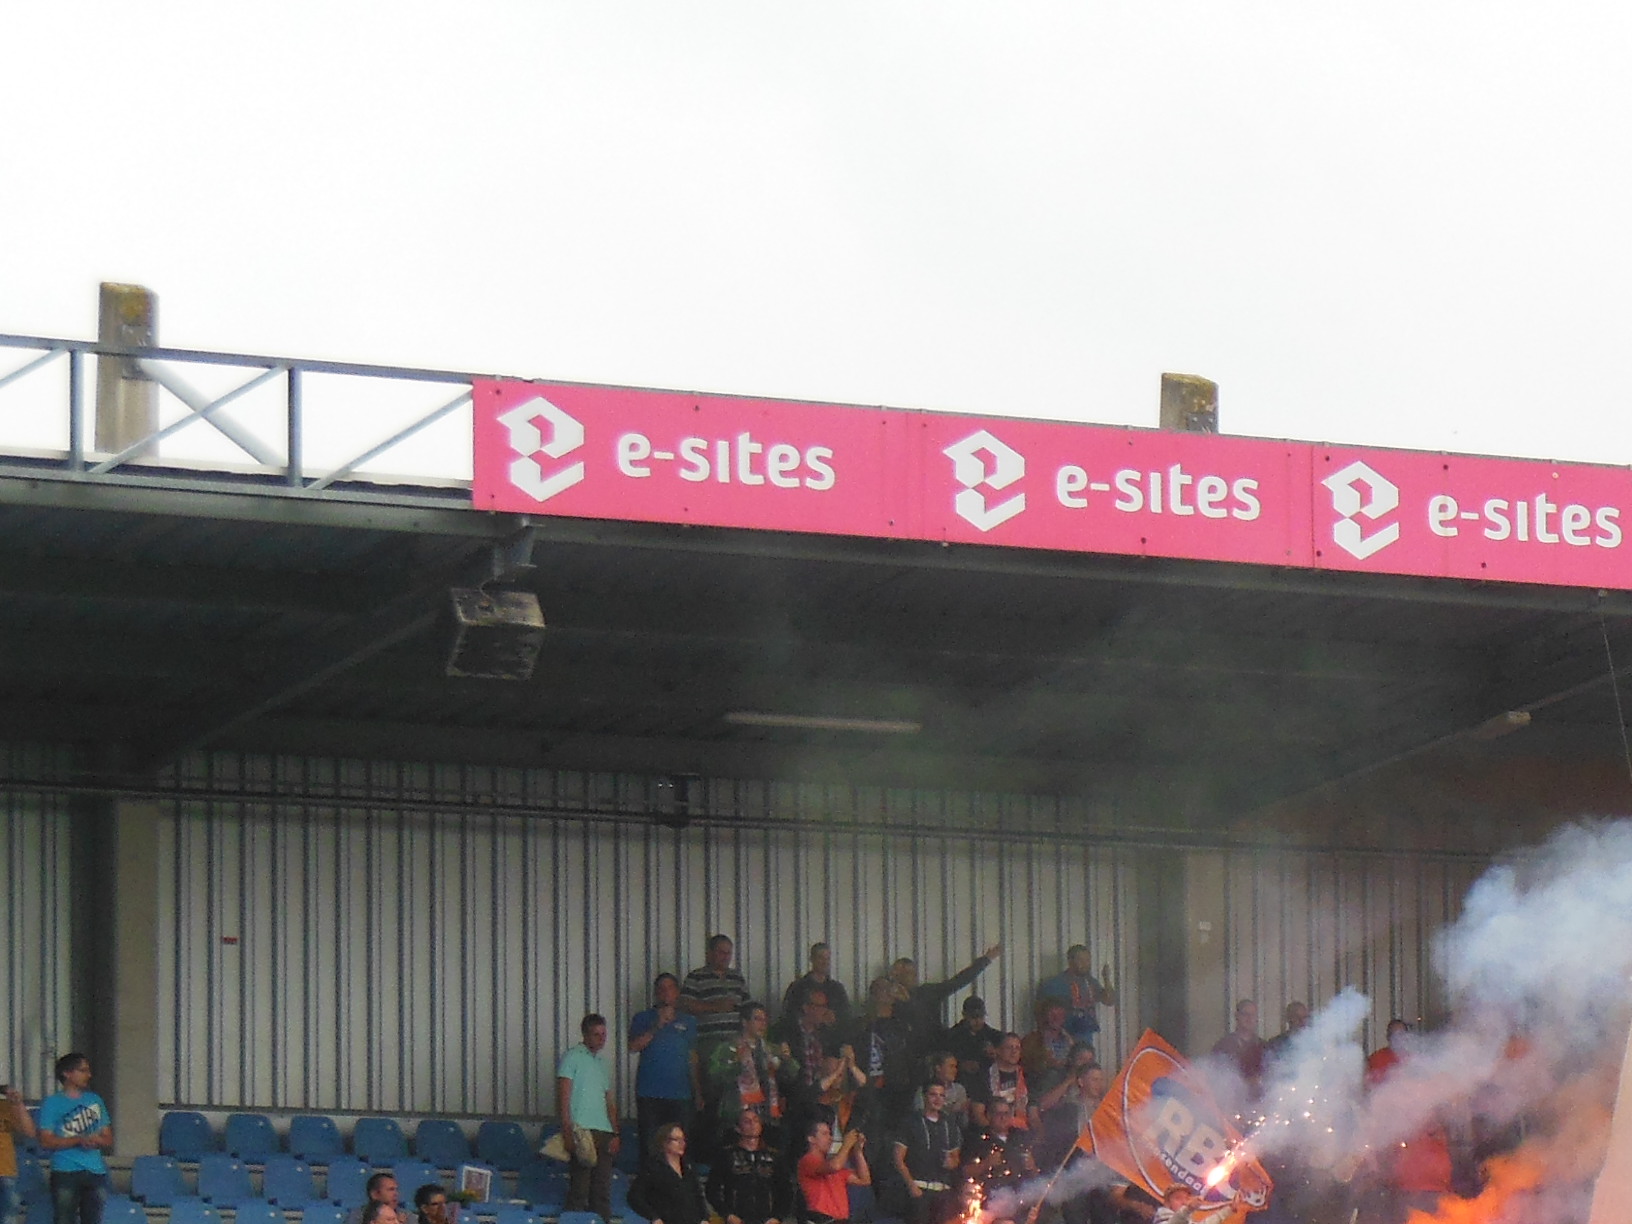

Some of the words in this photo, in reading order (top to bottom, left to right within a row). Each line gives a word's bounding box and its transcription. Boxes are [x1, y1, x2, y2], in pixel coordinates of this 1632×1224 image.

[617, 432, 836, 491] e-sites
[1056, 463, 1262, 521] e-sites
[1427, 492, 1623, 548] e-sites
